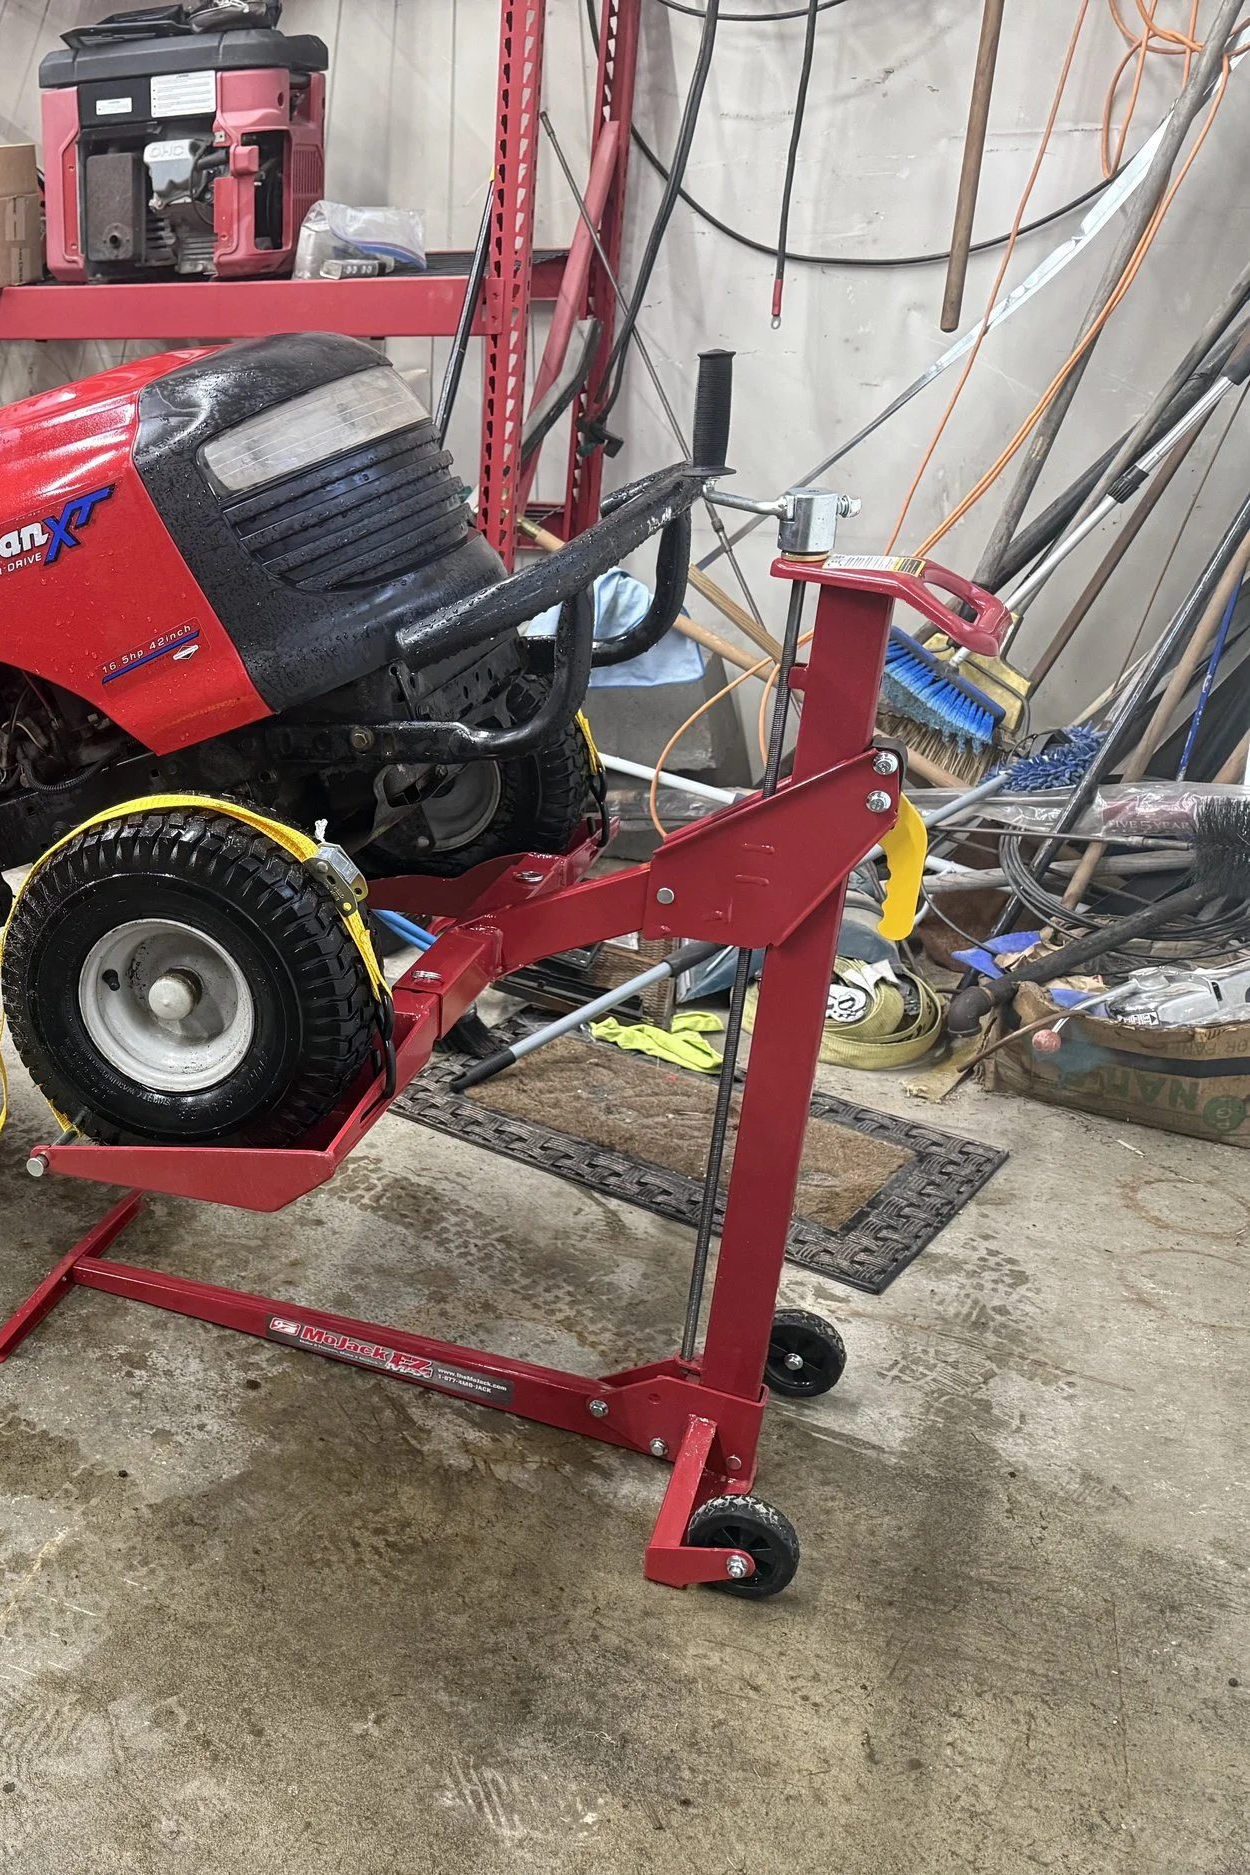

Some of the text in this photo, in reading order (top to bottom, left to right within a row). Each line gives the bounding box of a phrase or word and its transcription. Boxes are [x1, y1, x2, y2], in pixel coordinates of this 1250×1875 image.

[7, 552, 42, 572] DRIVE
[102, 649, 144, 674] 16.5hp
[149, 624, 191, 650] 42inch
[300, 1326, 387, 1361] MoJack
[390, 1350, 433, 1371] EZ
